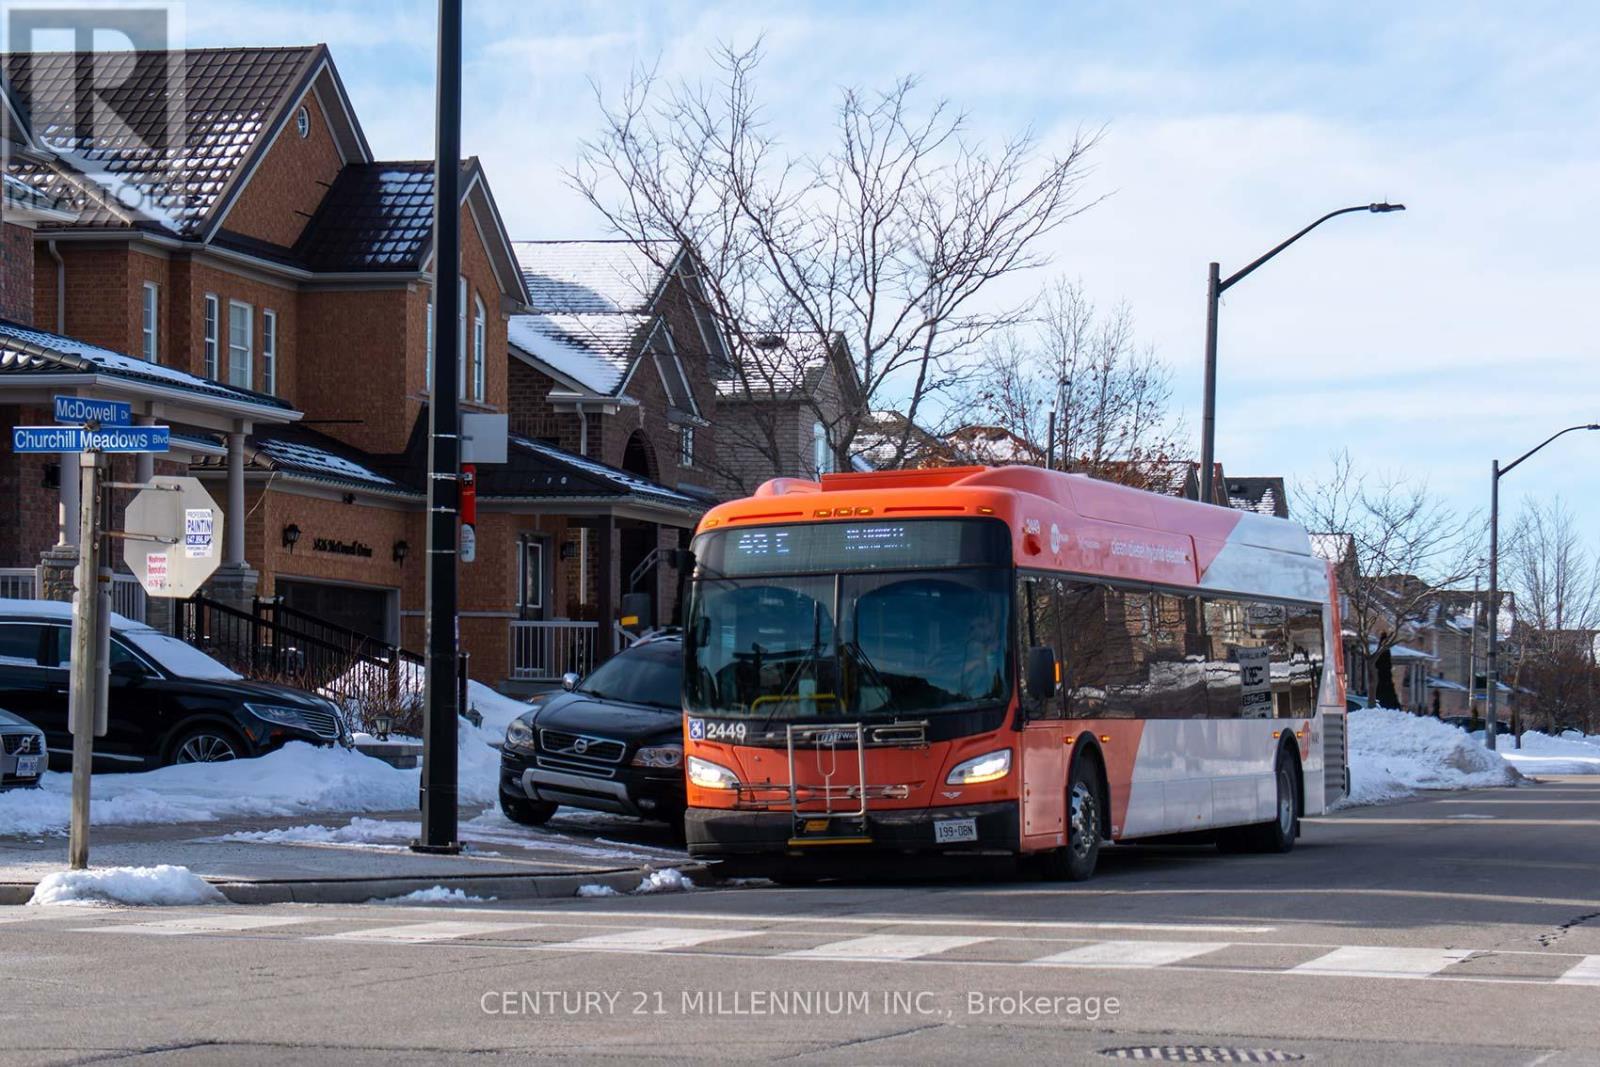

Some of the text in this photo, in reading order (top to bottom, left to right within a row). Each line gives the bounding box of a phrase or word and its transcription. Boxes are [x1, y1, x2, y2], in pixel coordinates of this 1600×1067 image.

[56, 400, 129, 421] McDowell Dr
[15, 430, 169, 448] Churchill Meadows Blvd
[187, 519, 213, 533] PAINTIN
[706, 722, 746, 739] 2449
